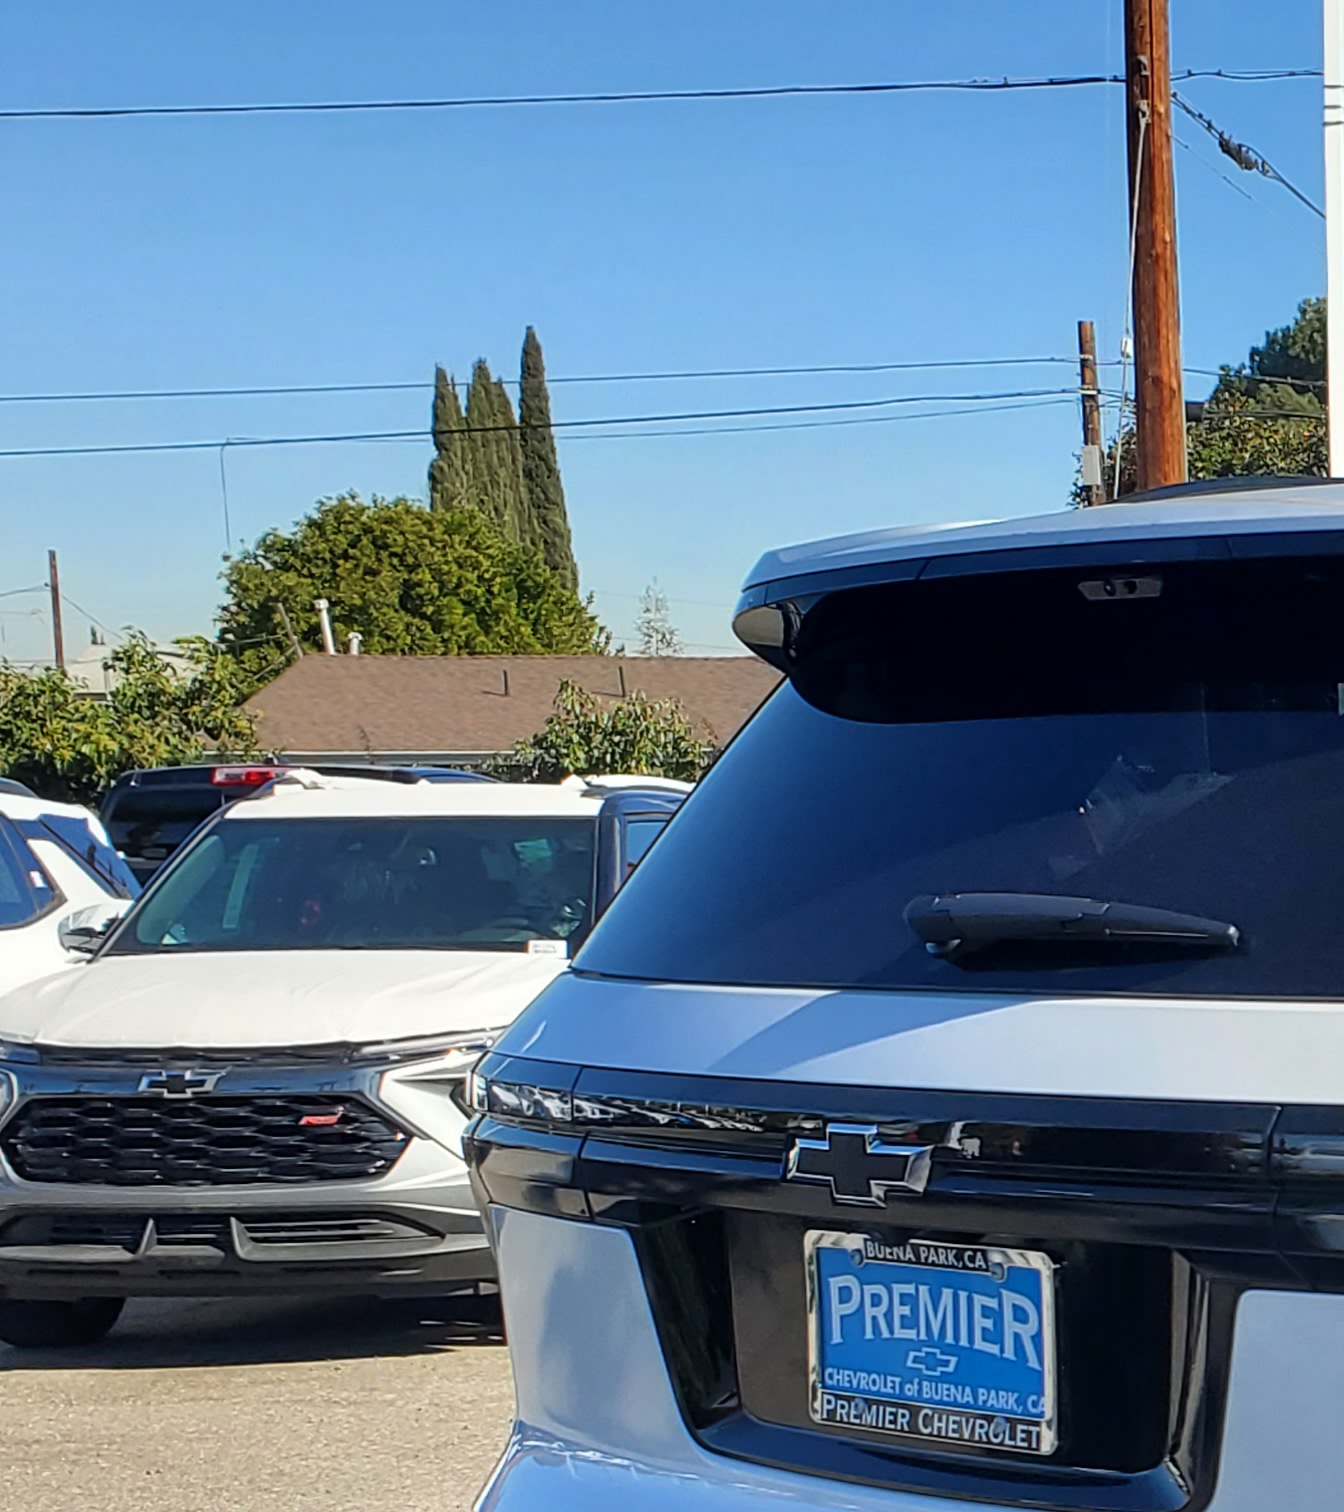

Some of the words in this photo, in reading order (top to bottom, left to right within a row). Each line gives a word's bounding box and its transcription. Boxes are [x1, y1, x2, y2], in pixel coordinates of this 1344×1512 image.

[865, 1240, 917, 1262] BUENA
[827, 1274, 1043, 1371] PREMIER
[825, 1367, 902, 1395] CHEVROLET
[904, 1380, 919, 1397] of
[922, 1386, 974, 1405] BUENA
[977, 1388, 1023, 1412] PARK,
[822, 1394, 910, 1431] PREMIER
[918, 1410, 1040, 1449] CHEVROLET
